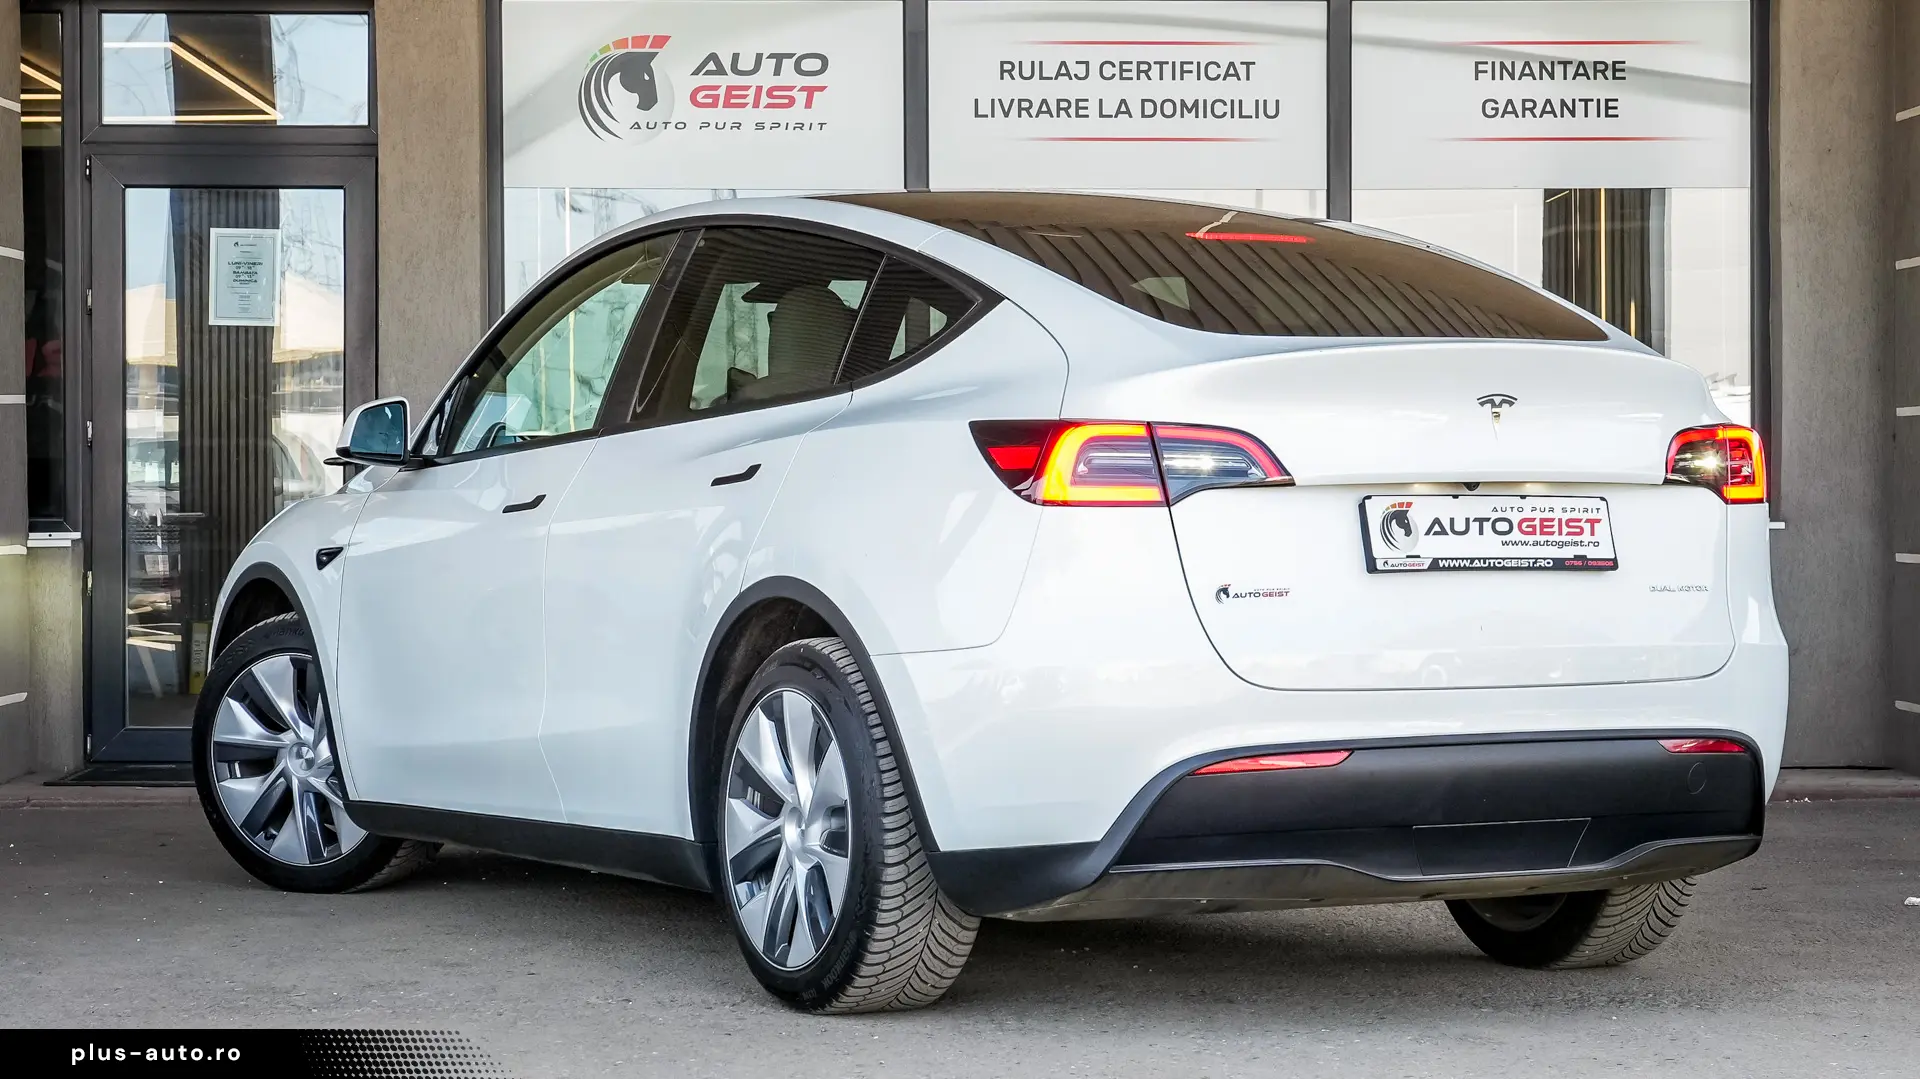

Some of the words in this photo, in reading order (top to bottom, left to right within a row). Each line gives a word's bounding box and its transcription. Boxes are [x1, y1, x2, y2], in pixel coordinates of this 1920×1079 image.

[691, 52, 829, 77] AUTO
[999, 60, 1090, 81] RULAJ
[1098, 60, 1256, 82] CERTIFICAT
[1474, 60, 1627, 81] FINANTARE
[690, 85, 829, 110] GEIST
[974, 98, 1090, 119] LIVRARE
[1098, 98, 1133, 119] LA
[1140, 98, 1280, 120] DOMICILIU
[1481, 98, 1619, 119] GARANTIE
[629, 121, 688, 131] AUTO
[699, 121, 742, 131] PUR
[754, 121, 828, 131] SPIRIT
[1501, 538, 1600, 549] www.autogeist.ro
[1438, 558, 1554, 568] WWW.AUTOGEIST.RO
